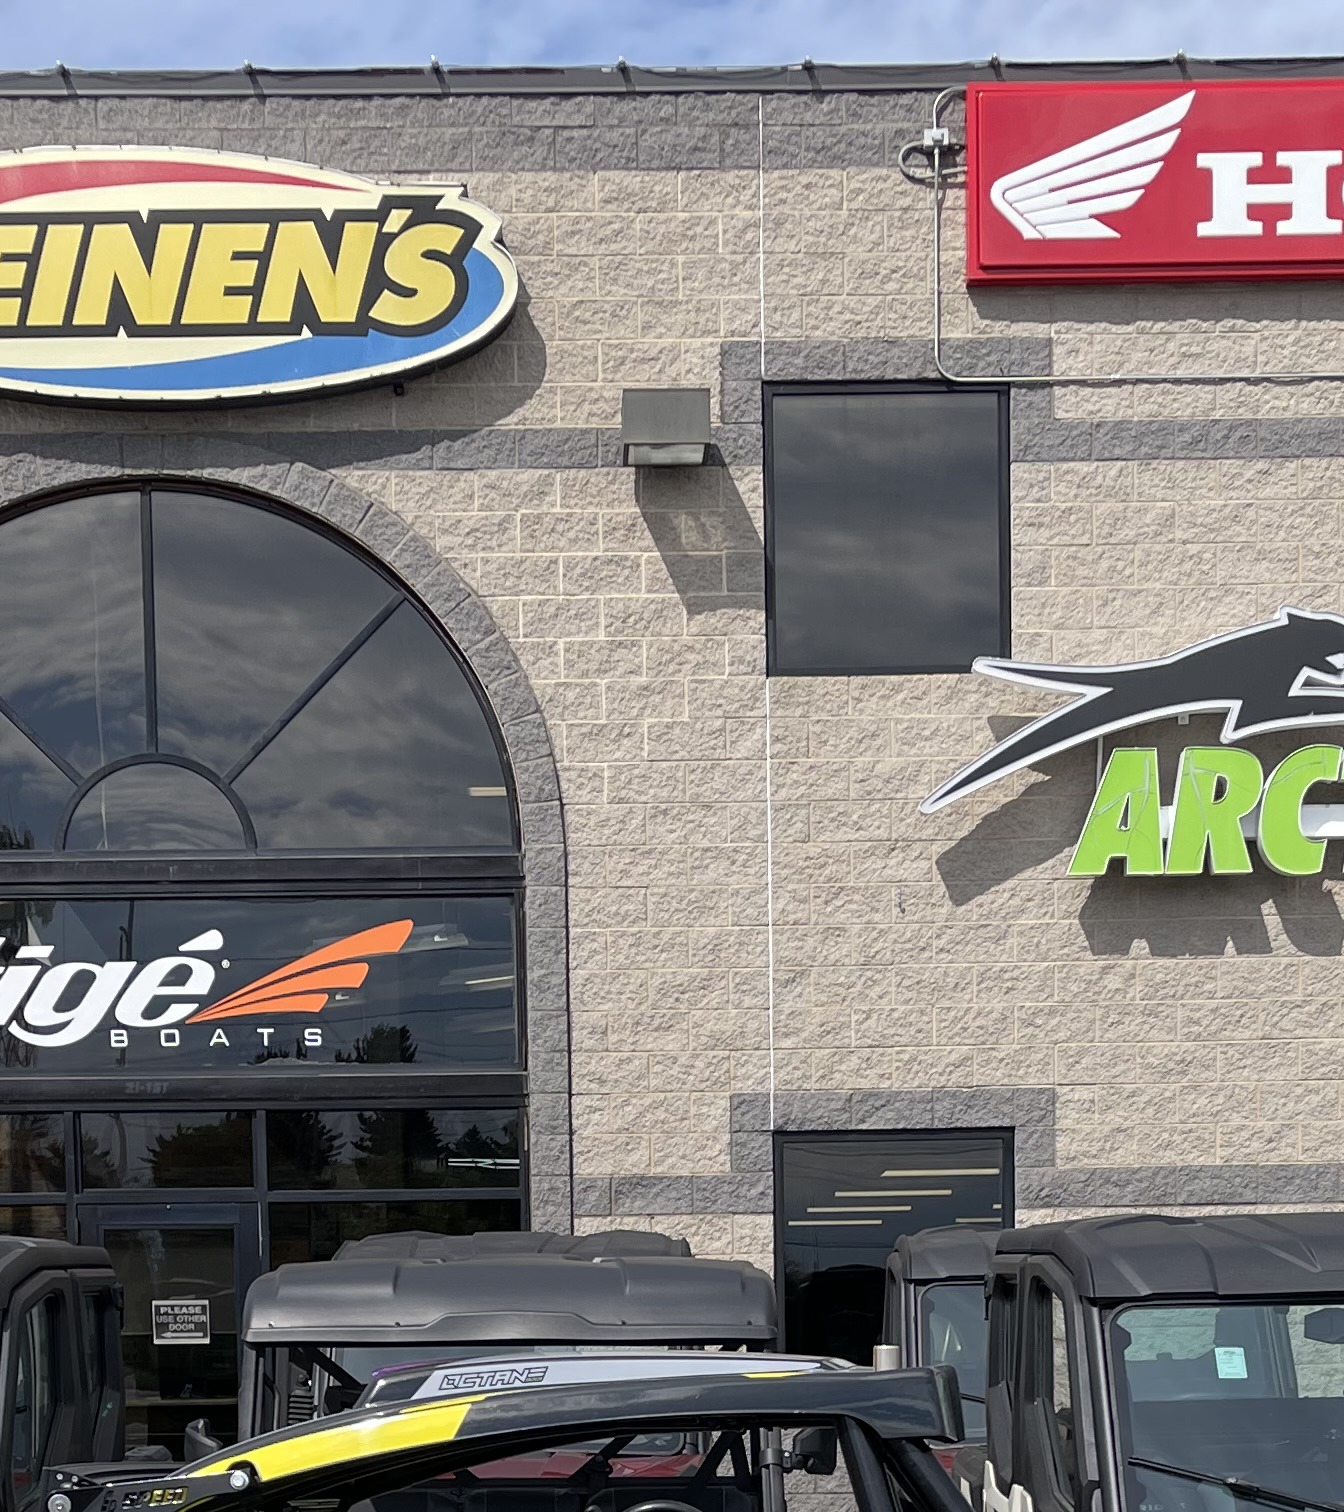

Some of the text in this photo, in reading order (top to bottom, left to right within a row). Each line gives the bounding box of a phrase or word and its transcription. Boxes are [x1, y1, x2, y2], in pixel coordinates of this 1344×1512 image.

[110, 1027, 323, 1048] BOATS
[159, 1306, 202, 1315] PLEASE
[156, 1314, 207, 1323] USE OTHER
[168, 1323, 195, 1331] DOOR
[438, 1365, 549, 1391] OCTANE
